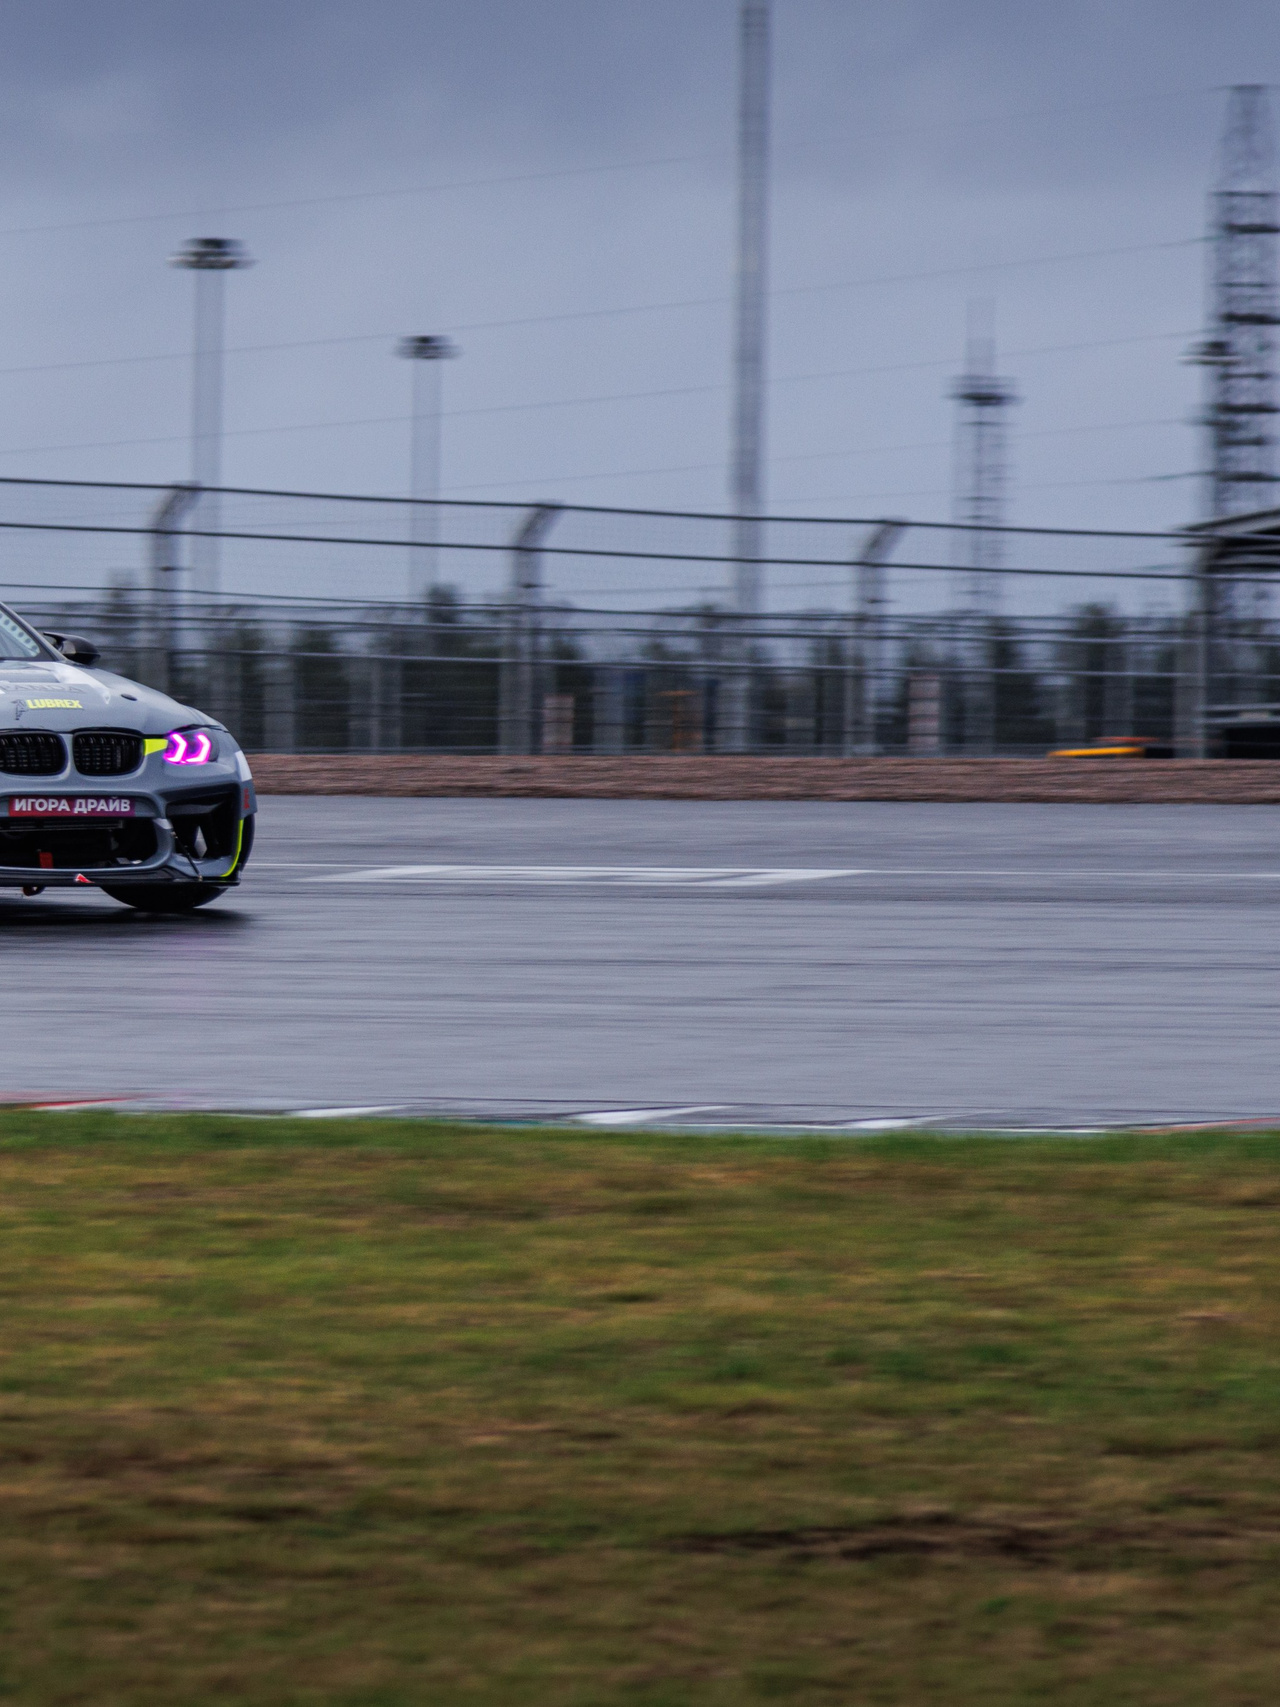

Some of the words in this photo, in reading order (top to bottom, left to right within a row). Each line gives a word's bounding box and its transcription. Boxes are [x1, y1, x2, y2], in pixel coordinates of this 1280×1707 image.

[26, 699, 83, 709] LUBREX
[14, 798, 71, 812] ИГОРА
[73, 796, 132, 814] ДРАЙВ
